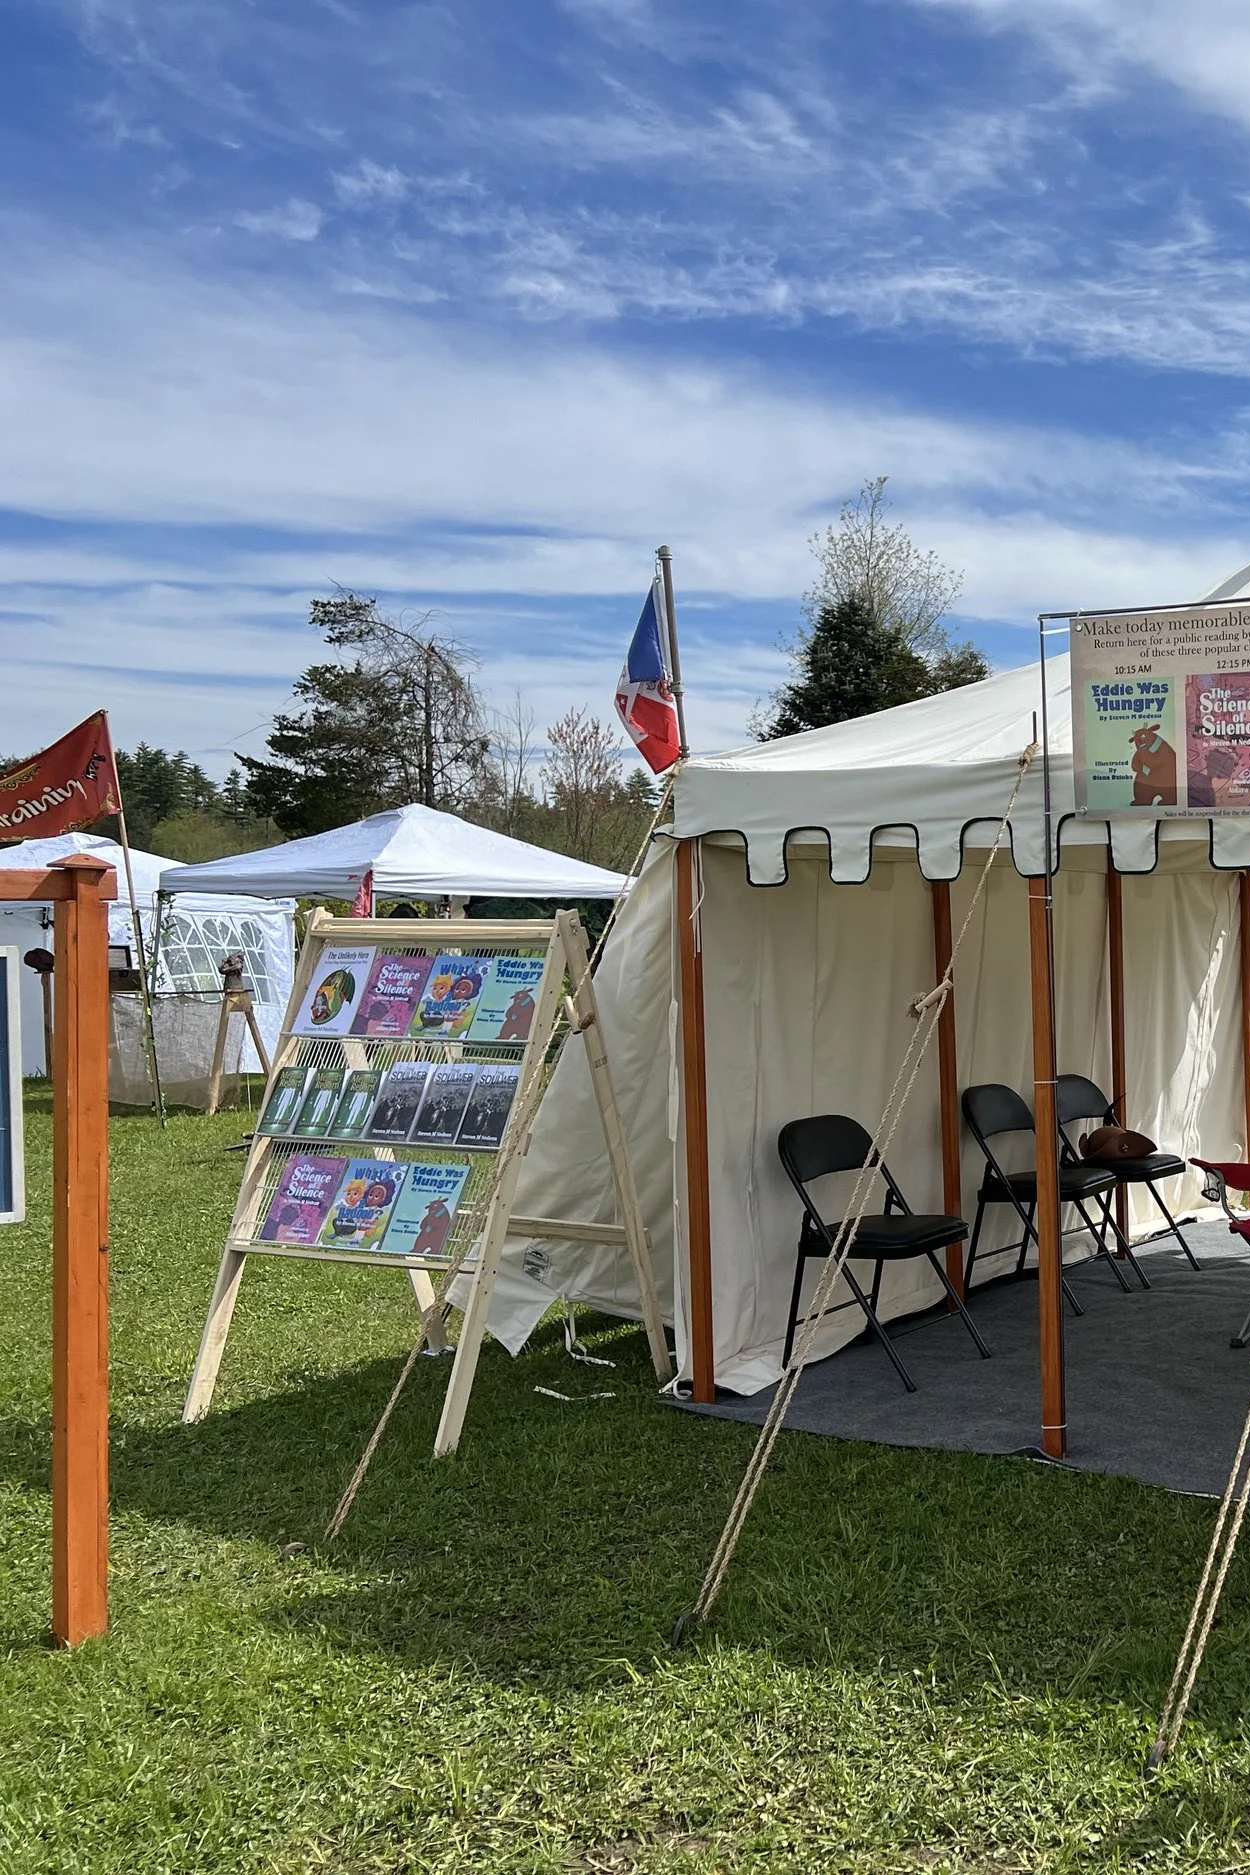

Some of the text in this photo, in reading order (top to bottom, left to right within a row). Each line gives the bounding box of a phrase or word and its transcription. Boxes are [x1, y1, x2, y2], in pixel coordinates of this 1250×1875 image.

[1082, 620, 1122, 636] Make
[1126, 618, 1165, 635] today
[1168, 611, 1250, 631] memorable
[1094, 638, 1125, 649] Return
[1126, 637, 1147, 647] here
[1150, 636, 1163, 646] for
[1173, 633, 1202, 647] public
[1204, 630, 1240, 644] reading
[1140, 649, 1151, 658] of
[1152, 647, 1176, 657] these
[1178, 645, 1202, 656] three
[1204, 643, 1241, 656] popular
[1114, 664, 1152, 675] 10:15 AM
[1216, 659, 1239, 669] 12:15
[1092, 682, 1169, 697] Eddie Was
[1209, 688, 1231, 700] The
[1094, 697, 1167, 713] Hungry
[1232, 711, 1245, 723] of
[497, 959, 527, 970] Eddie
[379, 965, 421, 981] Science
[496, 968, 543, 981] Hungry
[375, 979, 414, 995] Silence
[291, 1166, 332, 1183] Science
[301, 1164, 315, 1172] The
[413, 1166, 465, 1178] Eddie Was
[286, 1181, 325, 1198] Silence
[411, 1175, 460, 1190] Hungry
